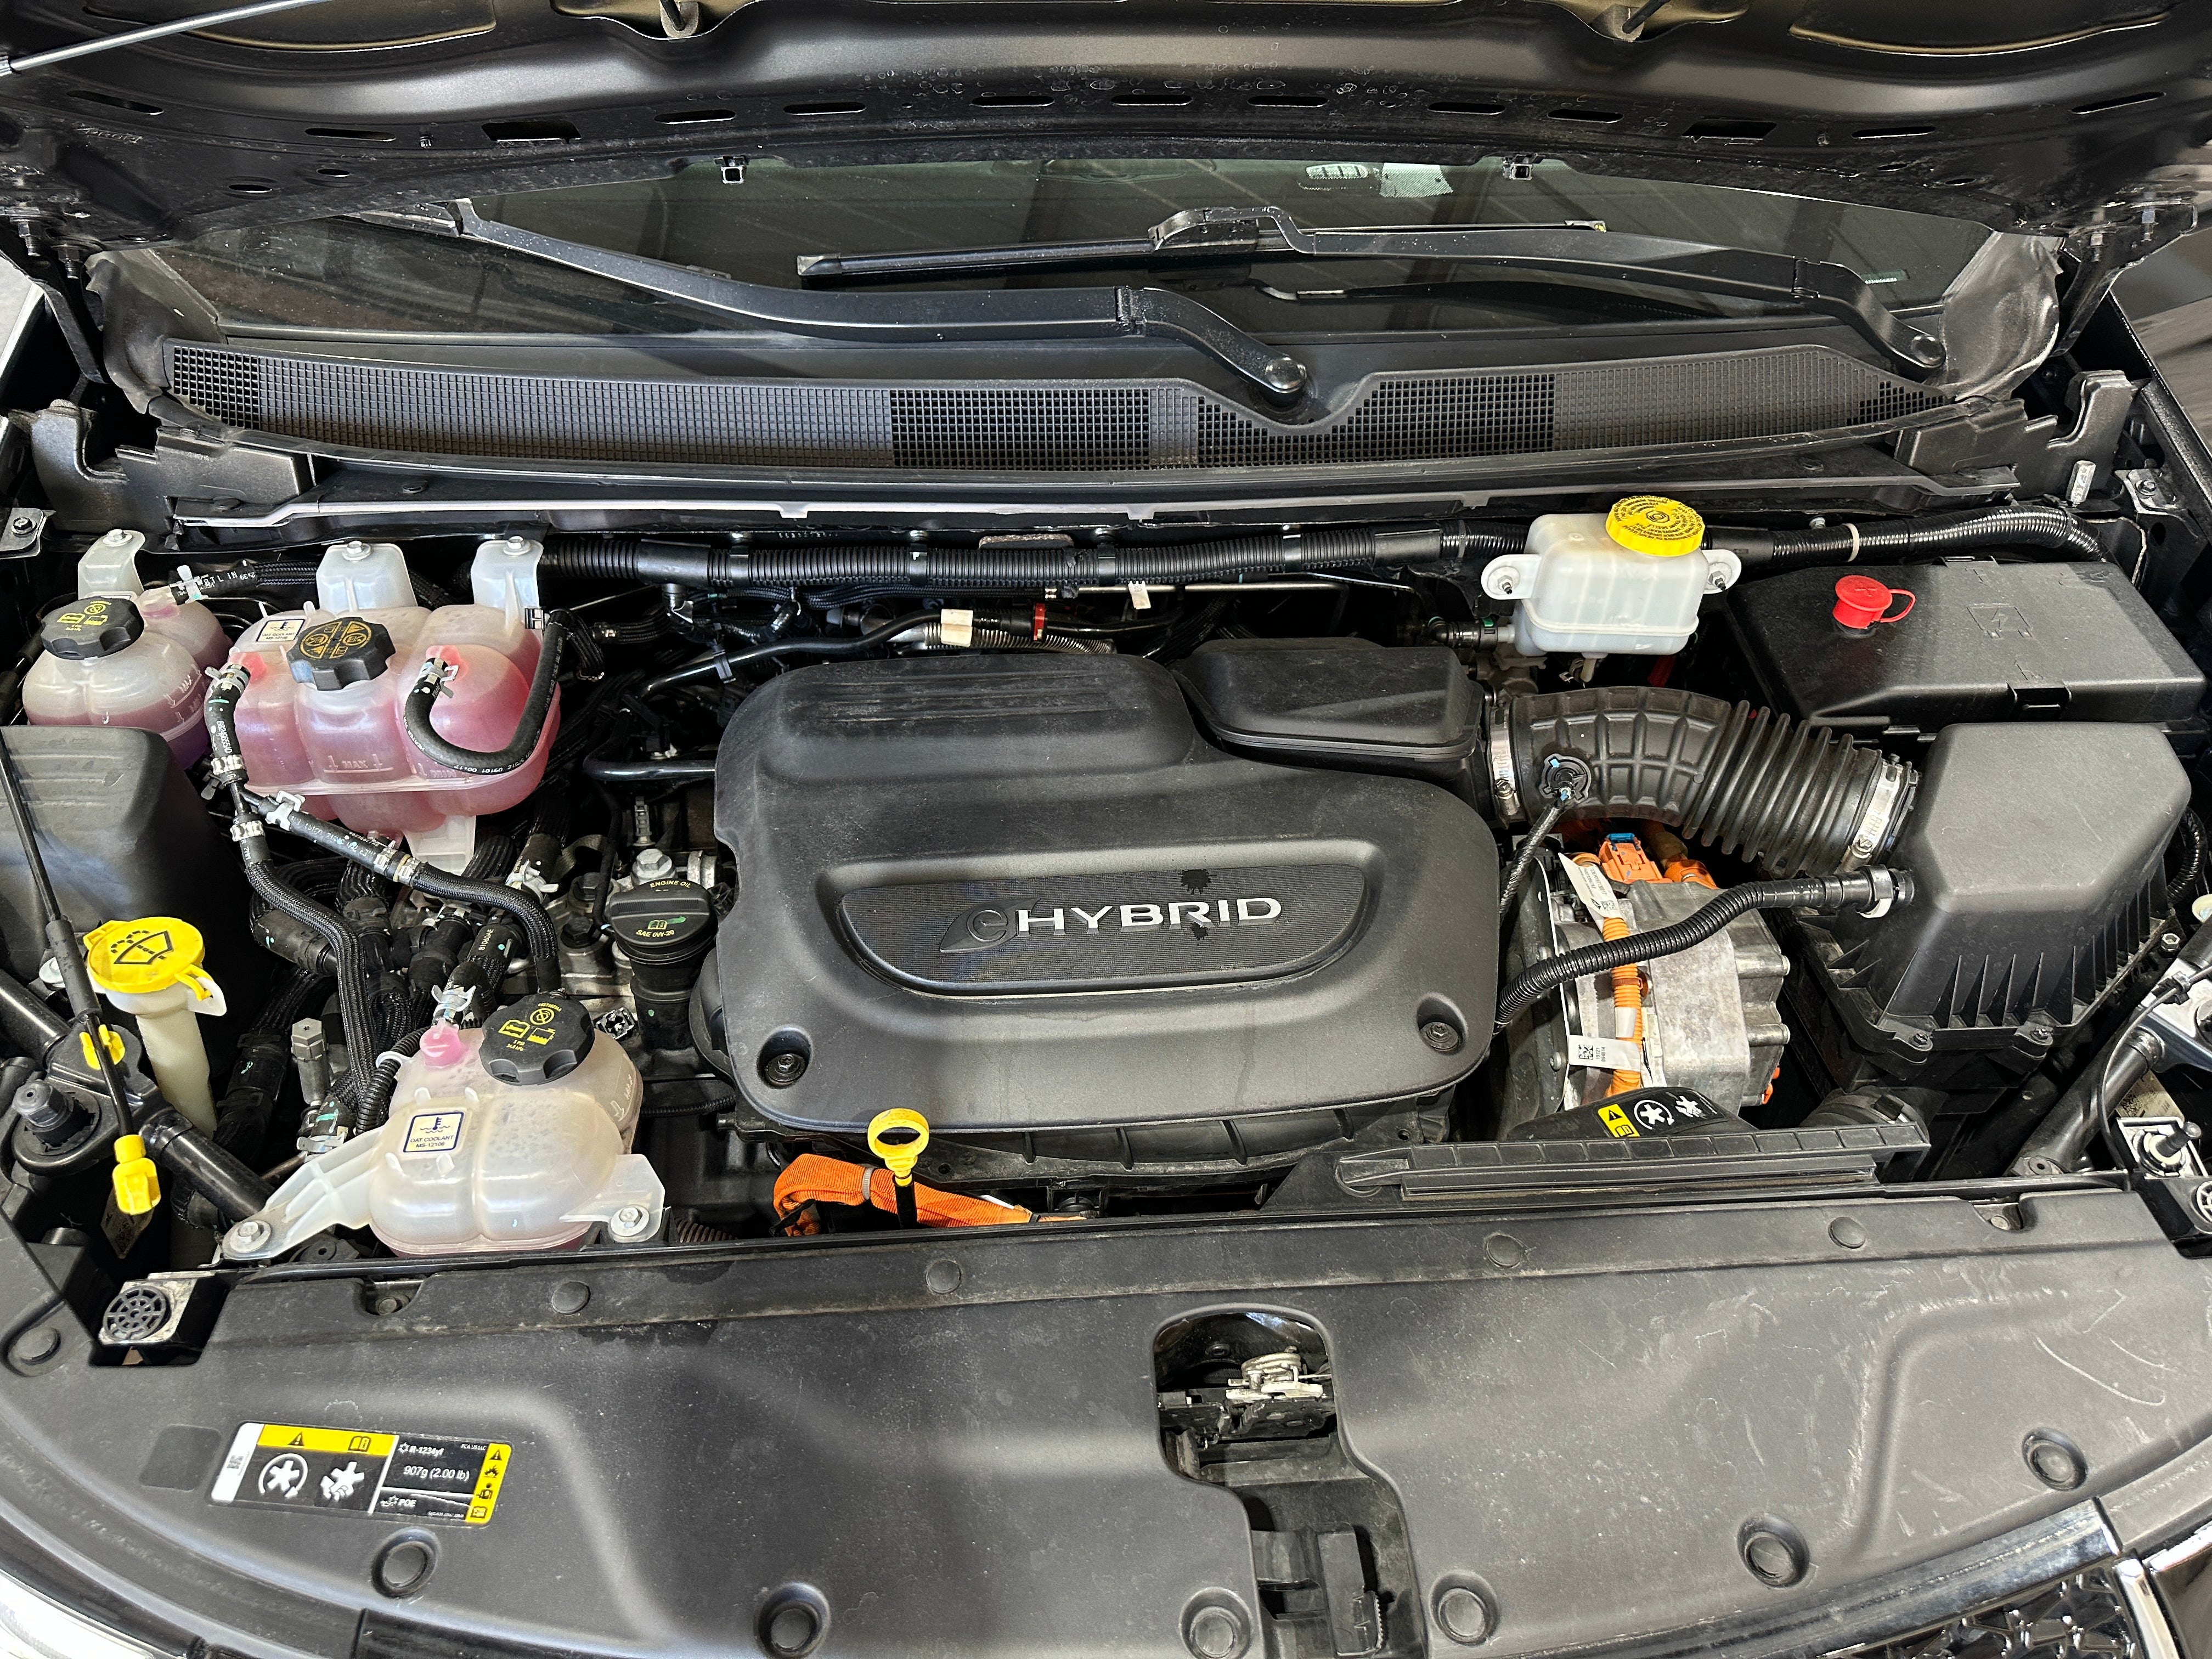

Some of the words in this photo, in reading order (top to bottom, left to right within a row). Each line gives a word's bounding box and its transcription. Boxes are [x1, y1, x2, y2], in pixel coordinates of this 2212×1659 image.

[227, 571, 238, 579] IN
[342, 759, 369, 769] MAX
[430, 769, 456, 778] MIN
[650, 880, 679, 888] ENGINE
[680, 881, 691, 889] OIL
[1017, 896, 1283, 936] HYBRID
[636, 929, 652, 938] SAE
[652, 929, 675, 938] 0W-20
[409, 1446, 444, 1457] R-1234yf
[403, 1465, 428, 1479] 907g
[430, 1467, 455, 1480] (2.00
[456, 1469, 470, 1482] lb)
[398, 1498, 417, 1508] POE
